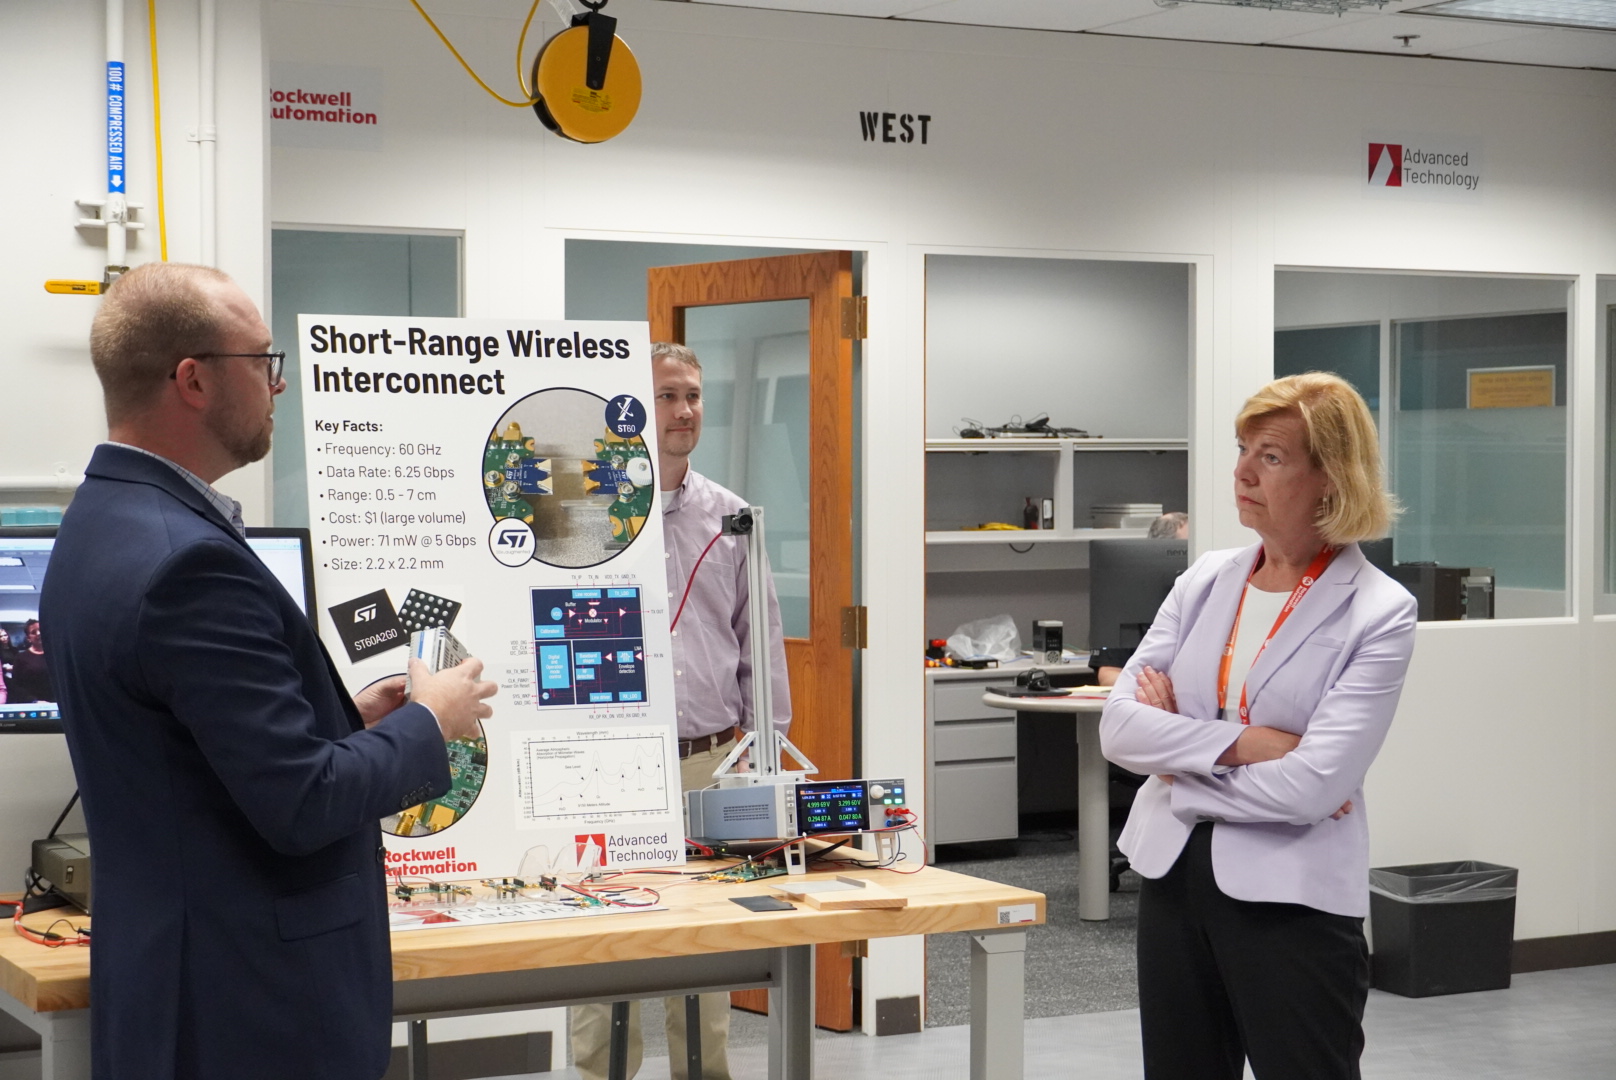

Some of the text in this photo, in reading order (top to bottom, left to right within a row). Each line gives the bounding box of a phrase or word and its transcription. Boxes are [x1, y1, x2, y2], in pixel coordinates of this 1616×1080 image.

[270, 89, 351, 107] ockwell
[108, 66, 123, 171] 100 # COMPRESSED AIR
[270, 105, 377, 125] utomation
[859, 111, 931, 145] WEST
[1403, 148, 1469, 167] Advanced
[1403, 168, 1480, 190] Technology
[310, 324, 630, 364] Short-Range Wireless
[313, 363, 506, 395] Interconnect
[315, 419, 383, 434] Key Facts:
[617, 424, 636, 433] ST60
[325, 443, 441, 458] Frequency: 60 GHz
[326, 466, 455, 480] Data Rate: 6.25 Gbps
[328, 489, 372, 503] Range:
[375, 489, 395, 500] 0.5
[407, 489, 414, 500] 7
[417, 491, 437, 500] cm
[329, 511, 466, 526] Cost: $1 (large volume)
[330, 535, 477, 549] Power: 71 mW @ 5 Gbps
[331, 558, 444, 570] Size: 2.2 x 2.2 mm
[608, 832, 668, 847] Advanced
[608, 848, 678, 863] Technology
